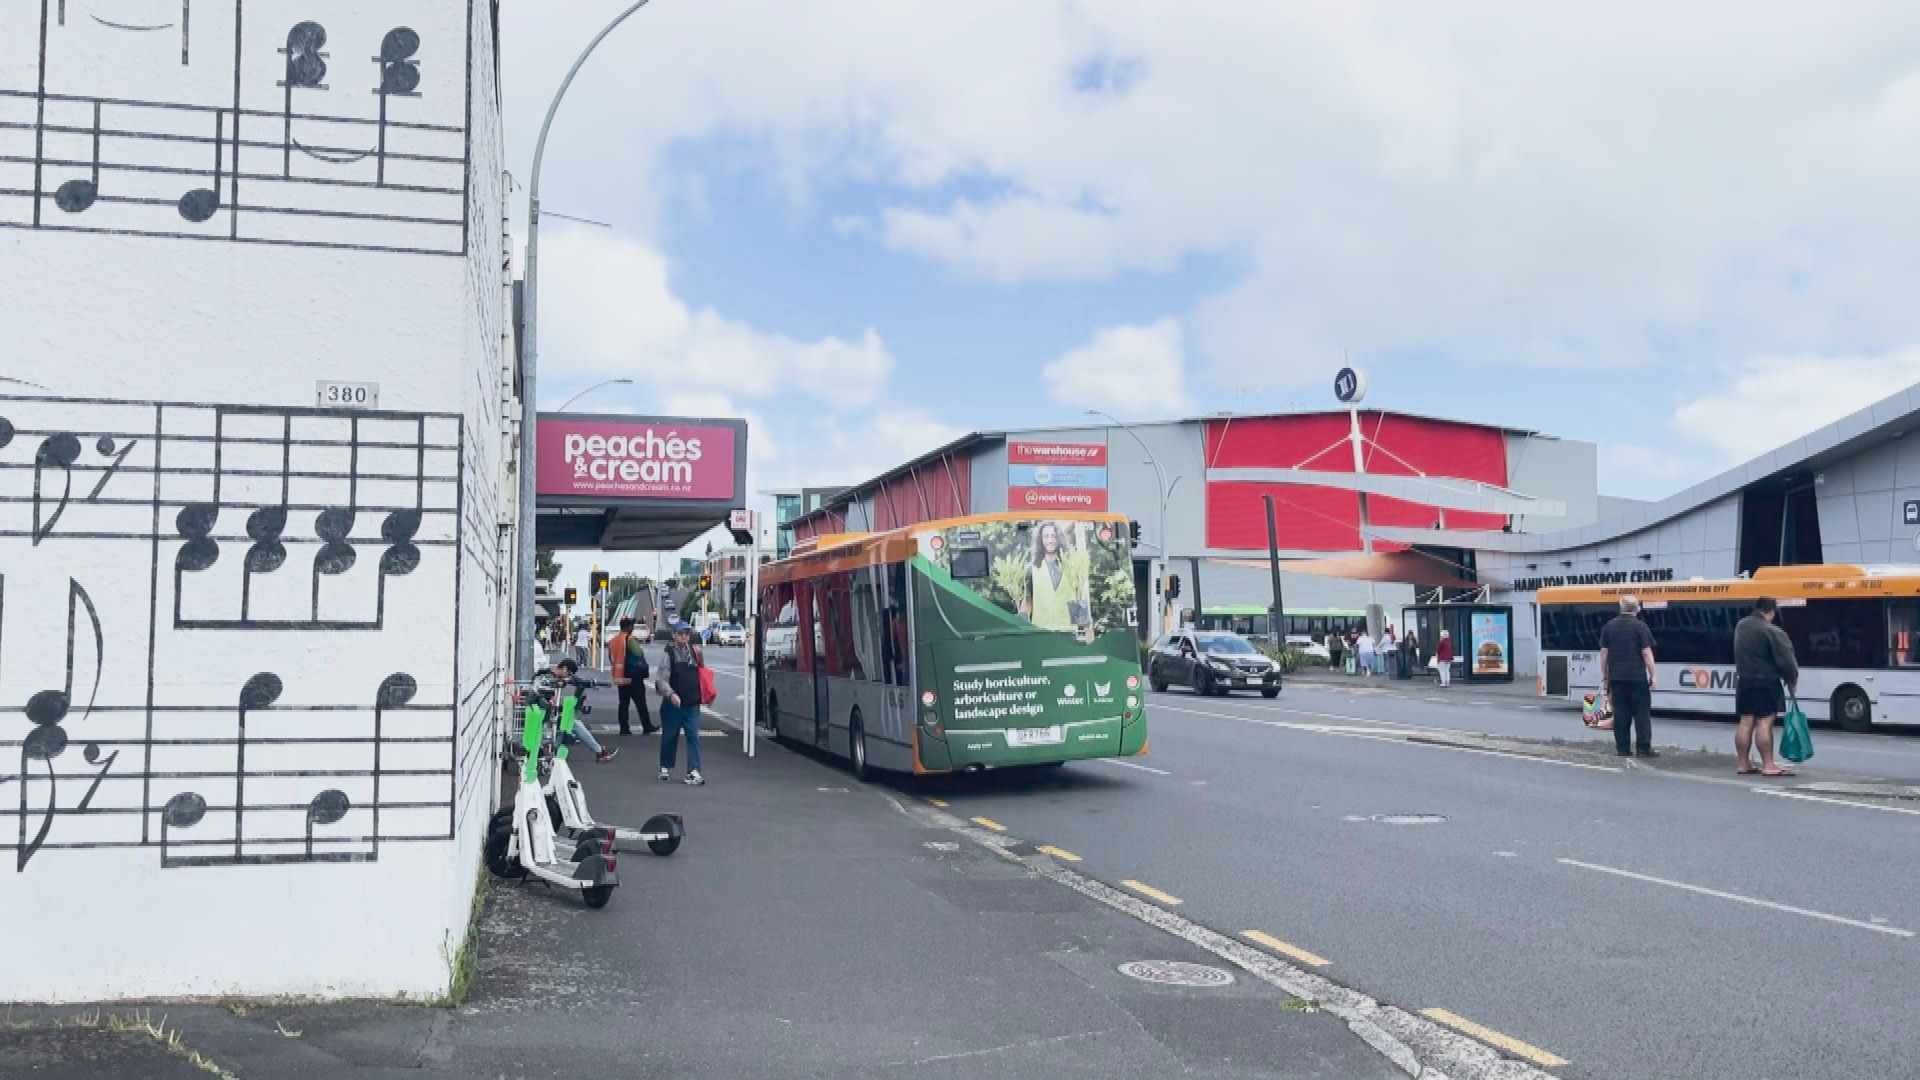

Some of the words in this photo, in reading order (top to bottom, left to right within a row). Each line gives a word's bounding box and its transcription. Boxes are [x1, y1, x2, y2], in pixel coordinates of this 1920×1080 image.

[327, 385, 366, 403] 380
[573, 455, 588, 478] &
[589, 457, 692, 483] cream
[572, 481, 692, 493] www.peachesandcream.co.nz
[1038, 493, 1057, 503] noel
[1058, 493, 1092, 505] leeming
[1514, 575, 1564, 592] HAMILTON
[1566, 571, 1628, 585] TRANSPORT
[1630, 567, 1674, 582] CENTRE
[953, 678, 984, 692] Study
[954, 691, 1023, 705] arboriculture
[1024, 690, 1037, 699] or
[955, 706, 1007, 720] landscape
[1009, 702, 1044, 717] design
